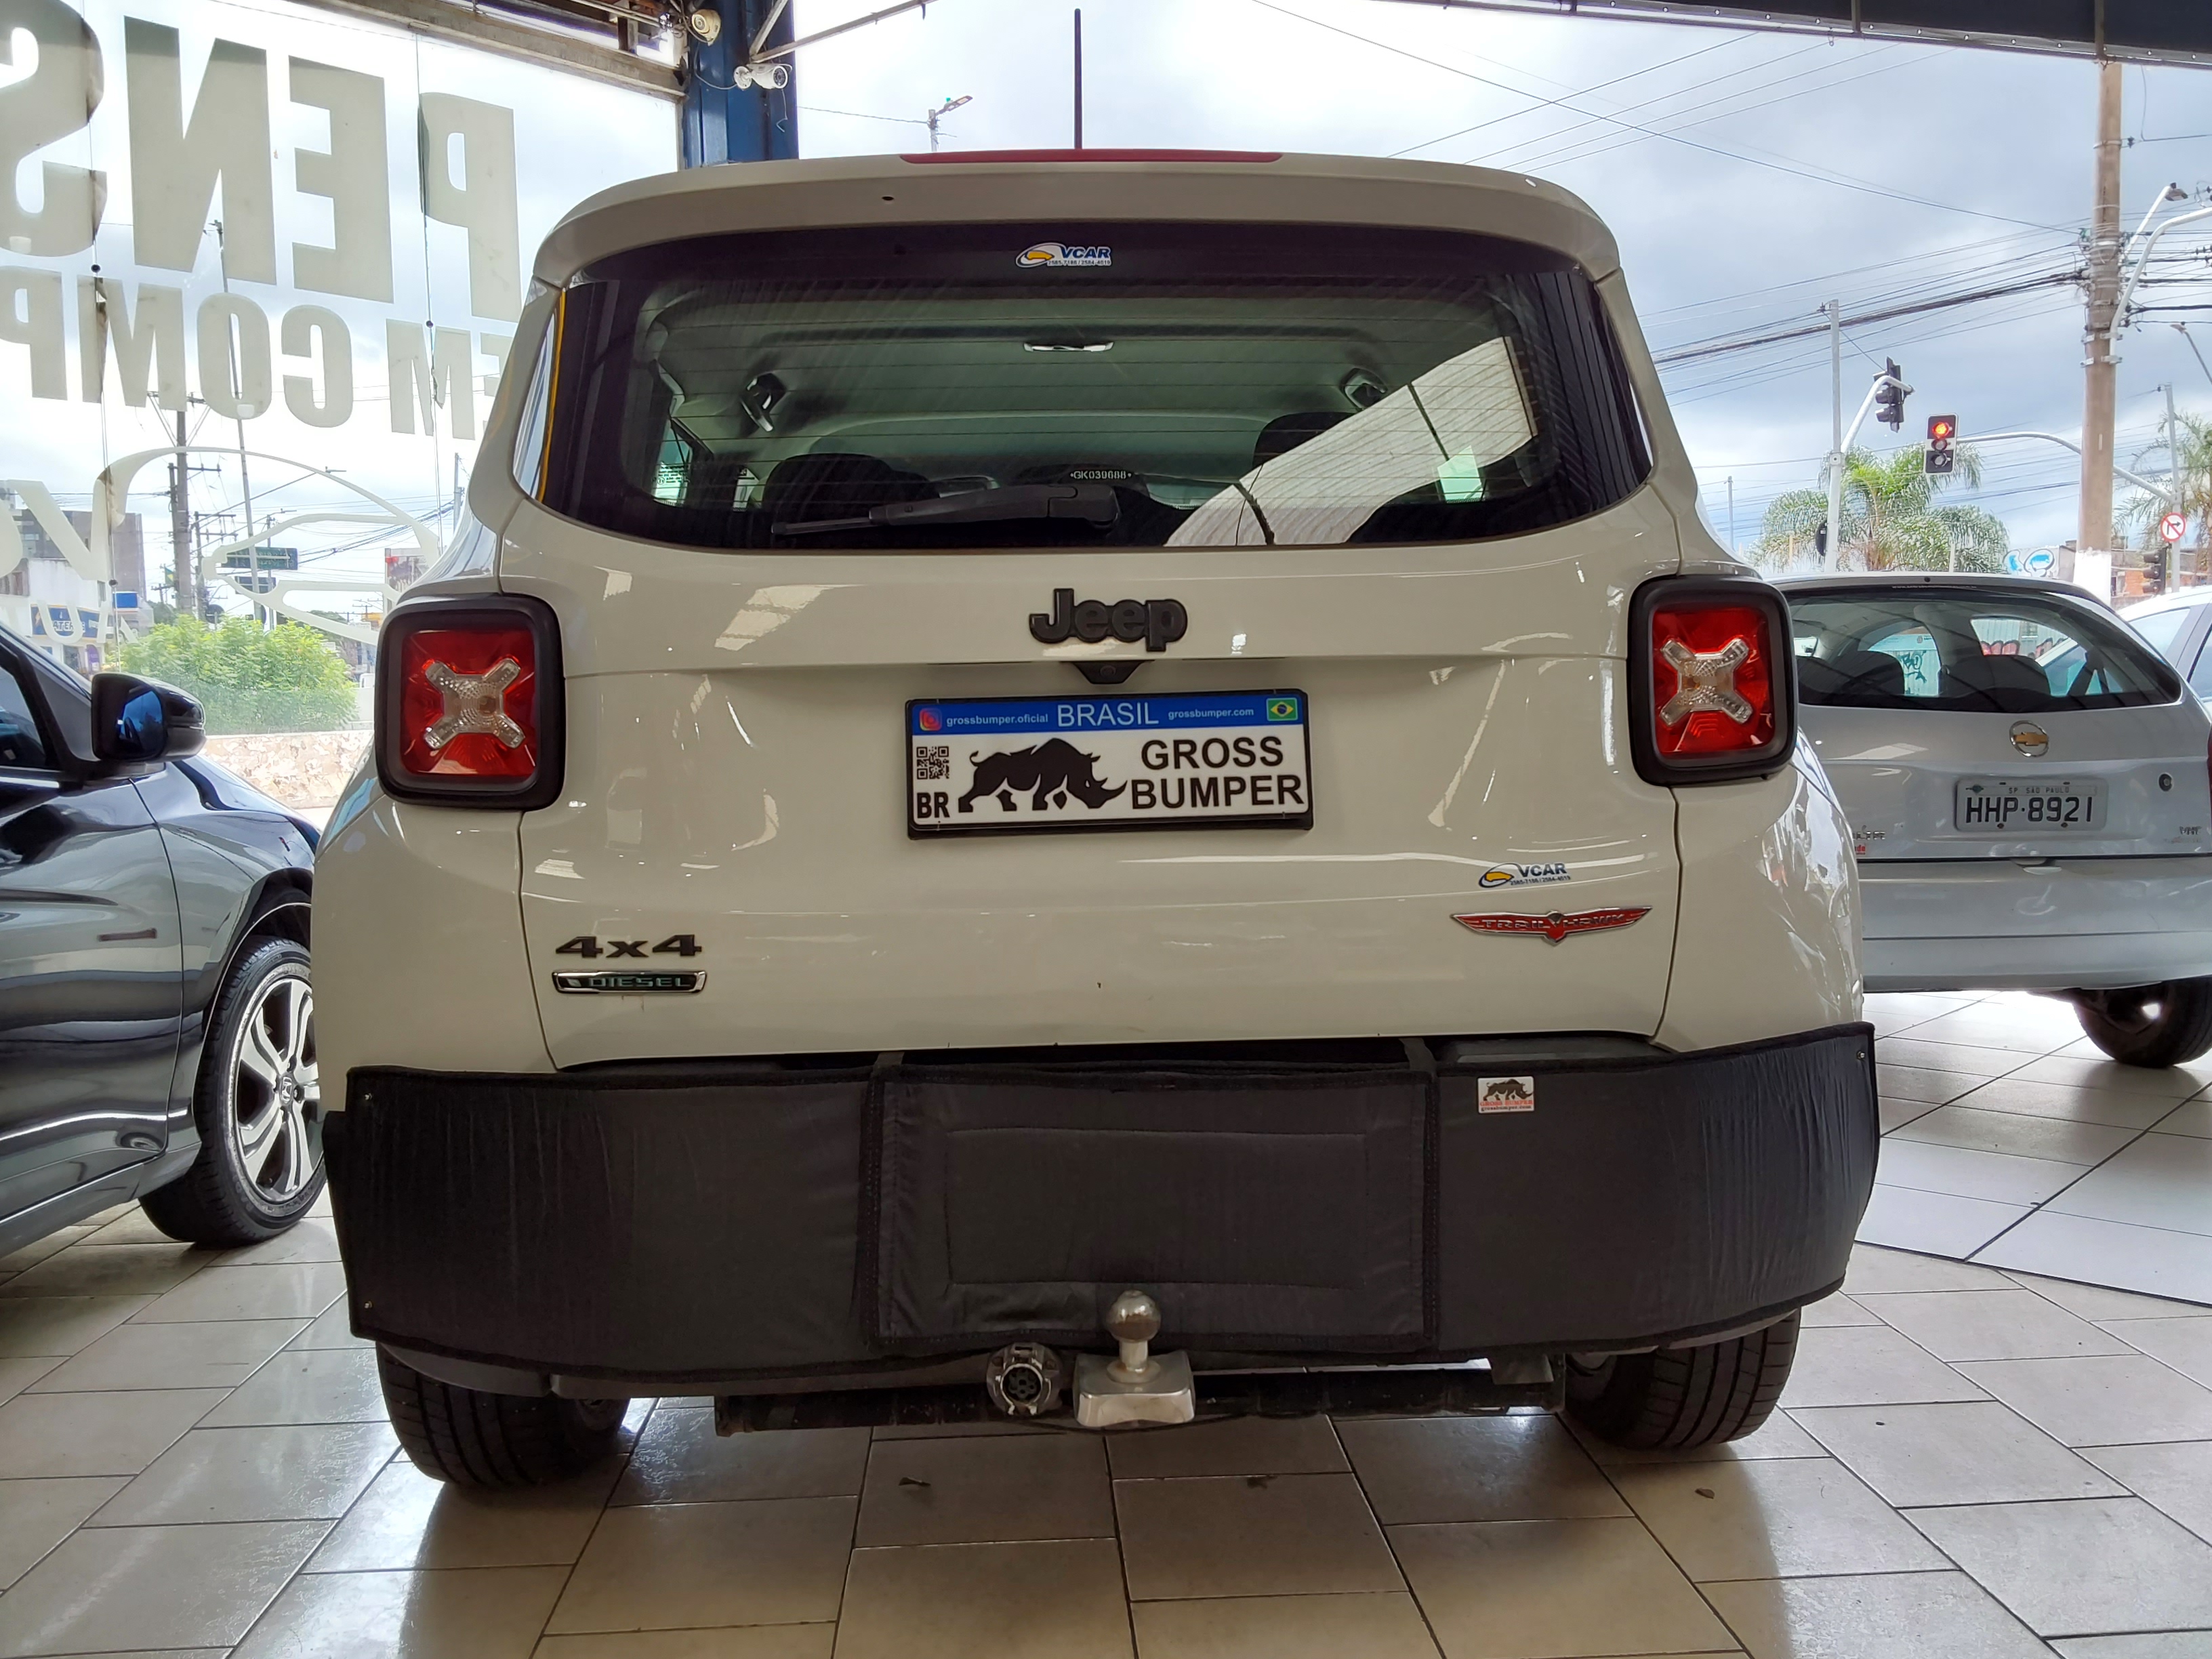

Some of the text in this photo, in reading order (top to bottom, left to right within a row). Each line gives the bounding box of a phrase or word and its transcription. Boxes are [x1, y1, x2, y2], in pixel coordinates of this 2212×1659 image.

[1061, 248, 1110, 259] VCAR
[1029, 588, 1187, 652] Jeep
[946, 702, 1254, 727] grossbumper.oficial BRASIL grossbumper.com
[1141, 736, 1284, 770] GROSS
[1131, 774, 1305, 810] BUMPER
[917, 792, 950, 819] BR
[1521, 863, 1567, 877] VCAR
[555, 934, 702, 958] 4x4
[588, 977, 691, 988] DIESEL
